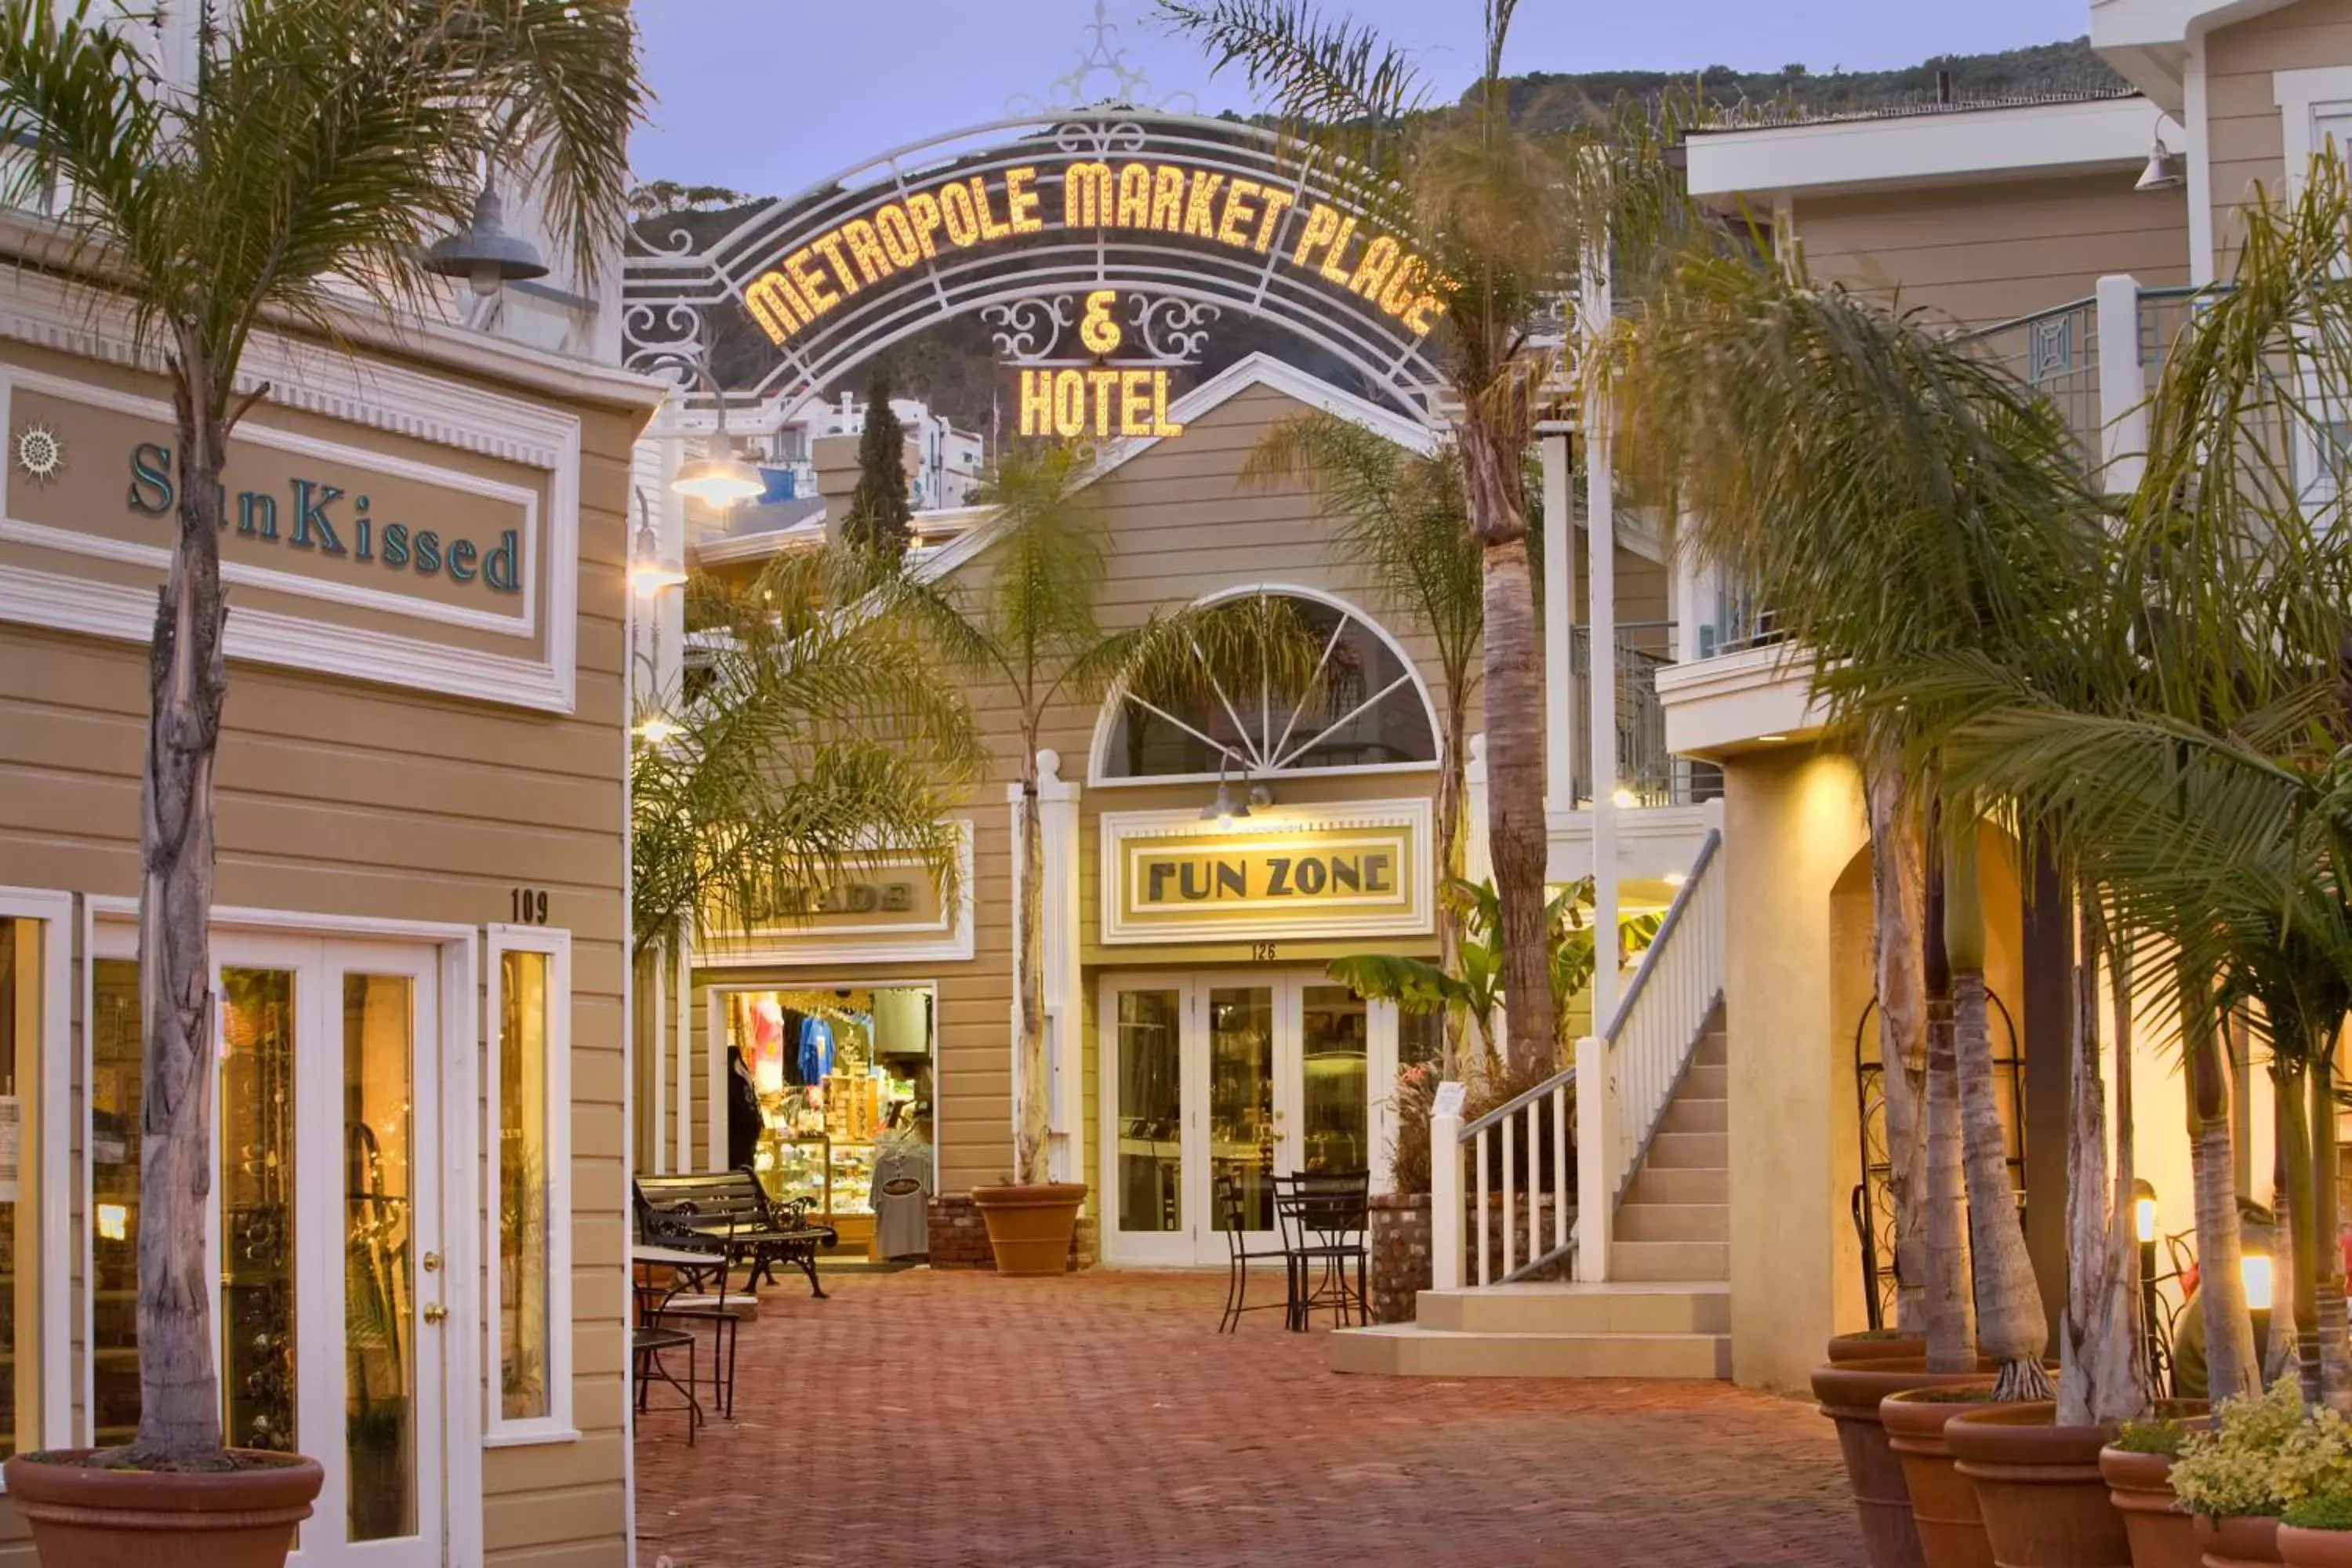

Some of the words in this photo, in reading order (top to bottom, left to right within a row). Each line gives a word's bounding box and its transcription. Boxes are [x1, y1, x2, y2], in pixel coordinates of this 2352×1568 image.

[746, 167, 1042, 345] METROPOLE
[1065, 163, 1294, 253] MARKET
[1080, 290, 1120, 352] &
[1021, 370, 1184, 437] HOTEL
[511, 887, 548, 924] 109
[1149, 860, 1246, 902] FUN
[1267, 855, 1390, 896] ZONE
[1252, 943, 1276, 962] 126
